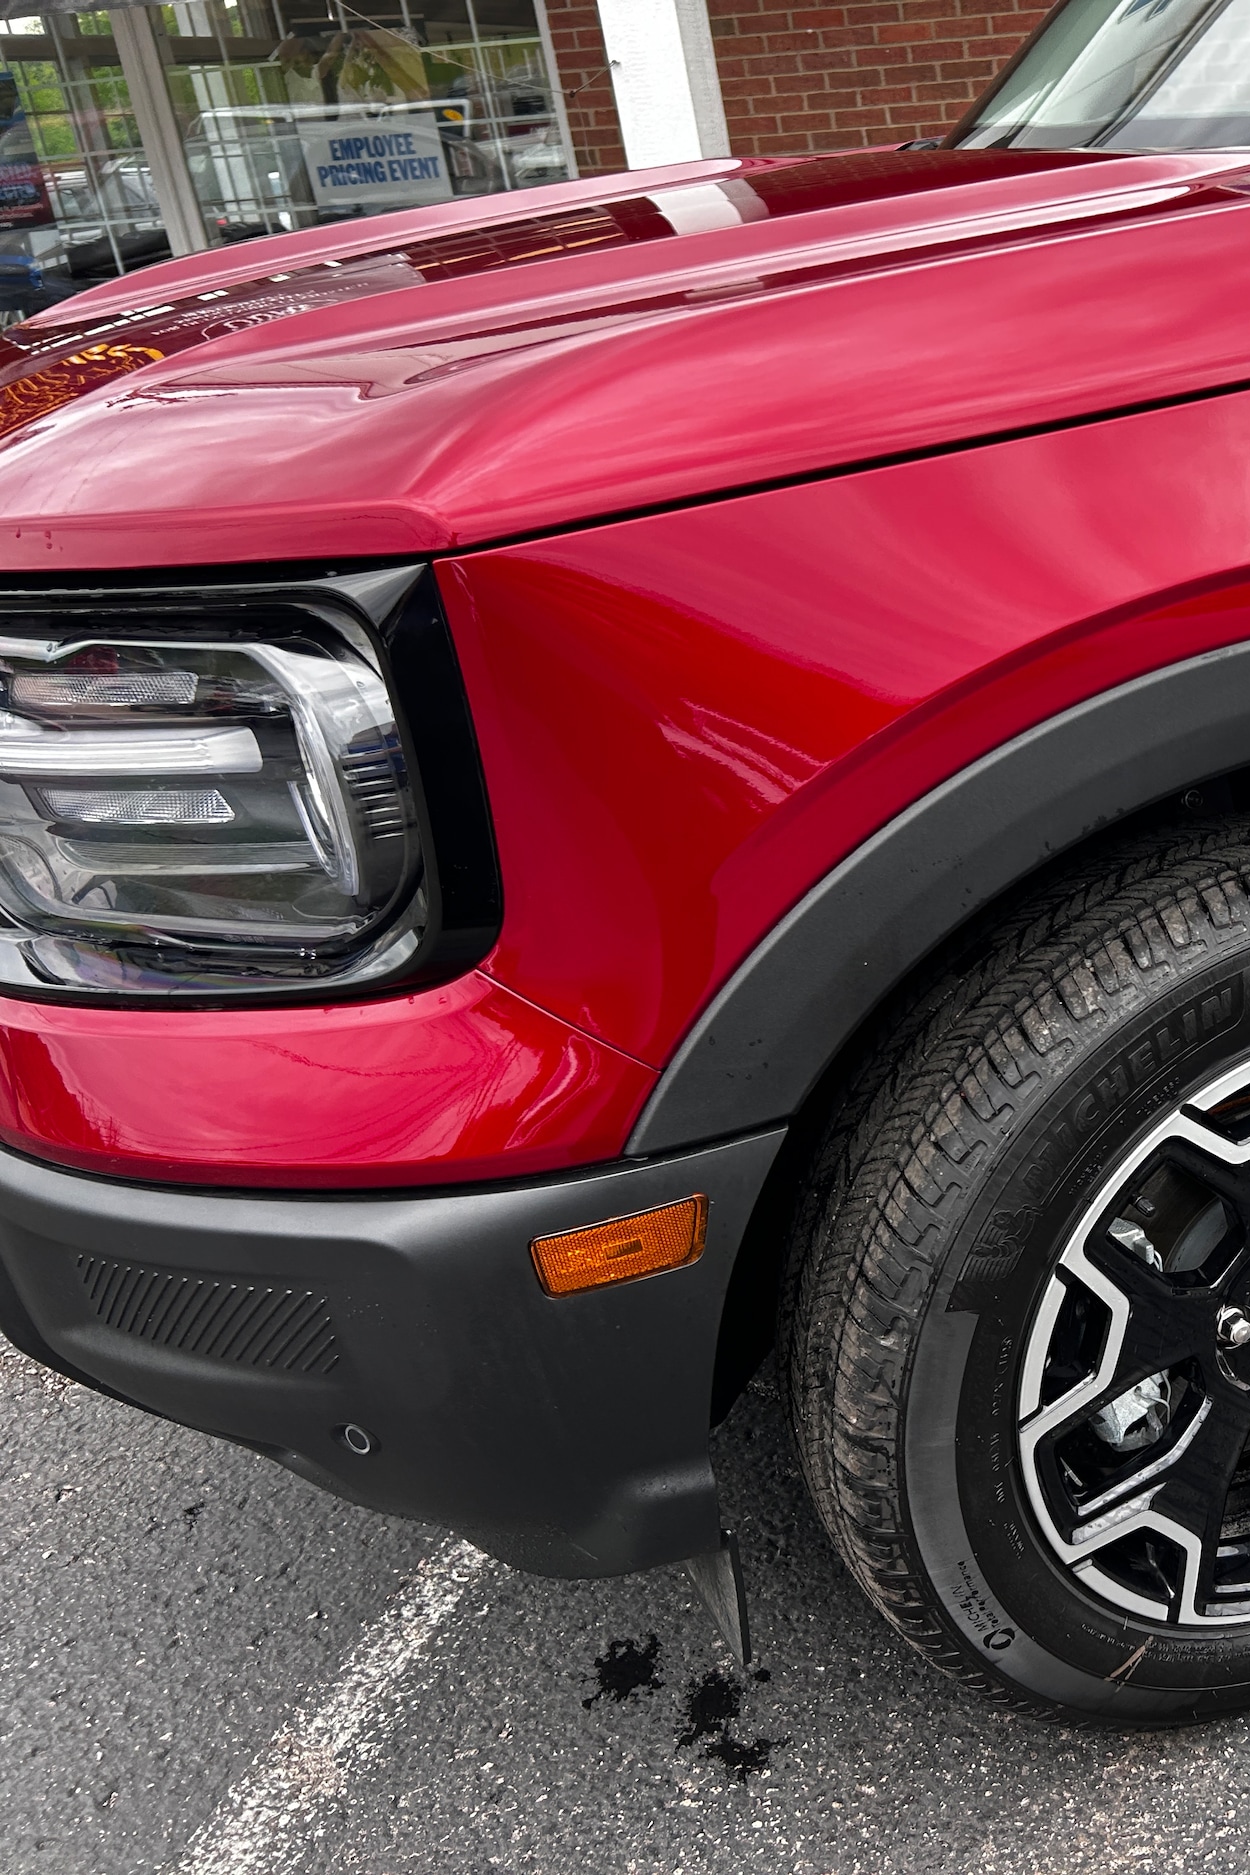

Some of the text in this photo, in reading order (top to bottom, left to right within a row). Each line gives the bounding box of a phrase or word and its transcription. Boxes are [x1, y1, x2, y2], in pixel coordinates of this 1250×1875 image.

[328, 132, 418, 162] EMPLOYEE
[316, 156, 442, 188] PRICING EVENT
[1021, 985, 1234, 1198] MICHELIN
[949, 1584, 989, 1632] MICHELIN
